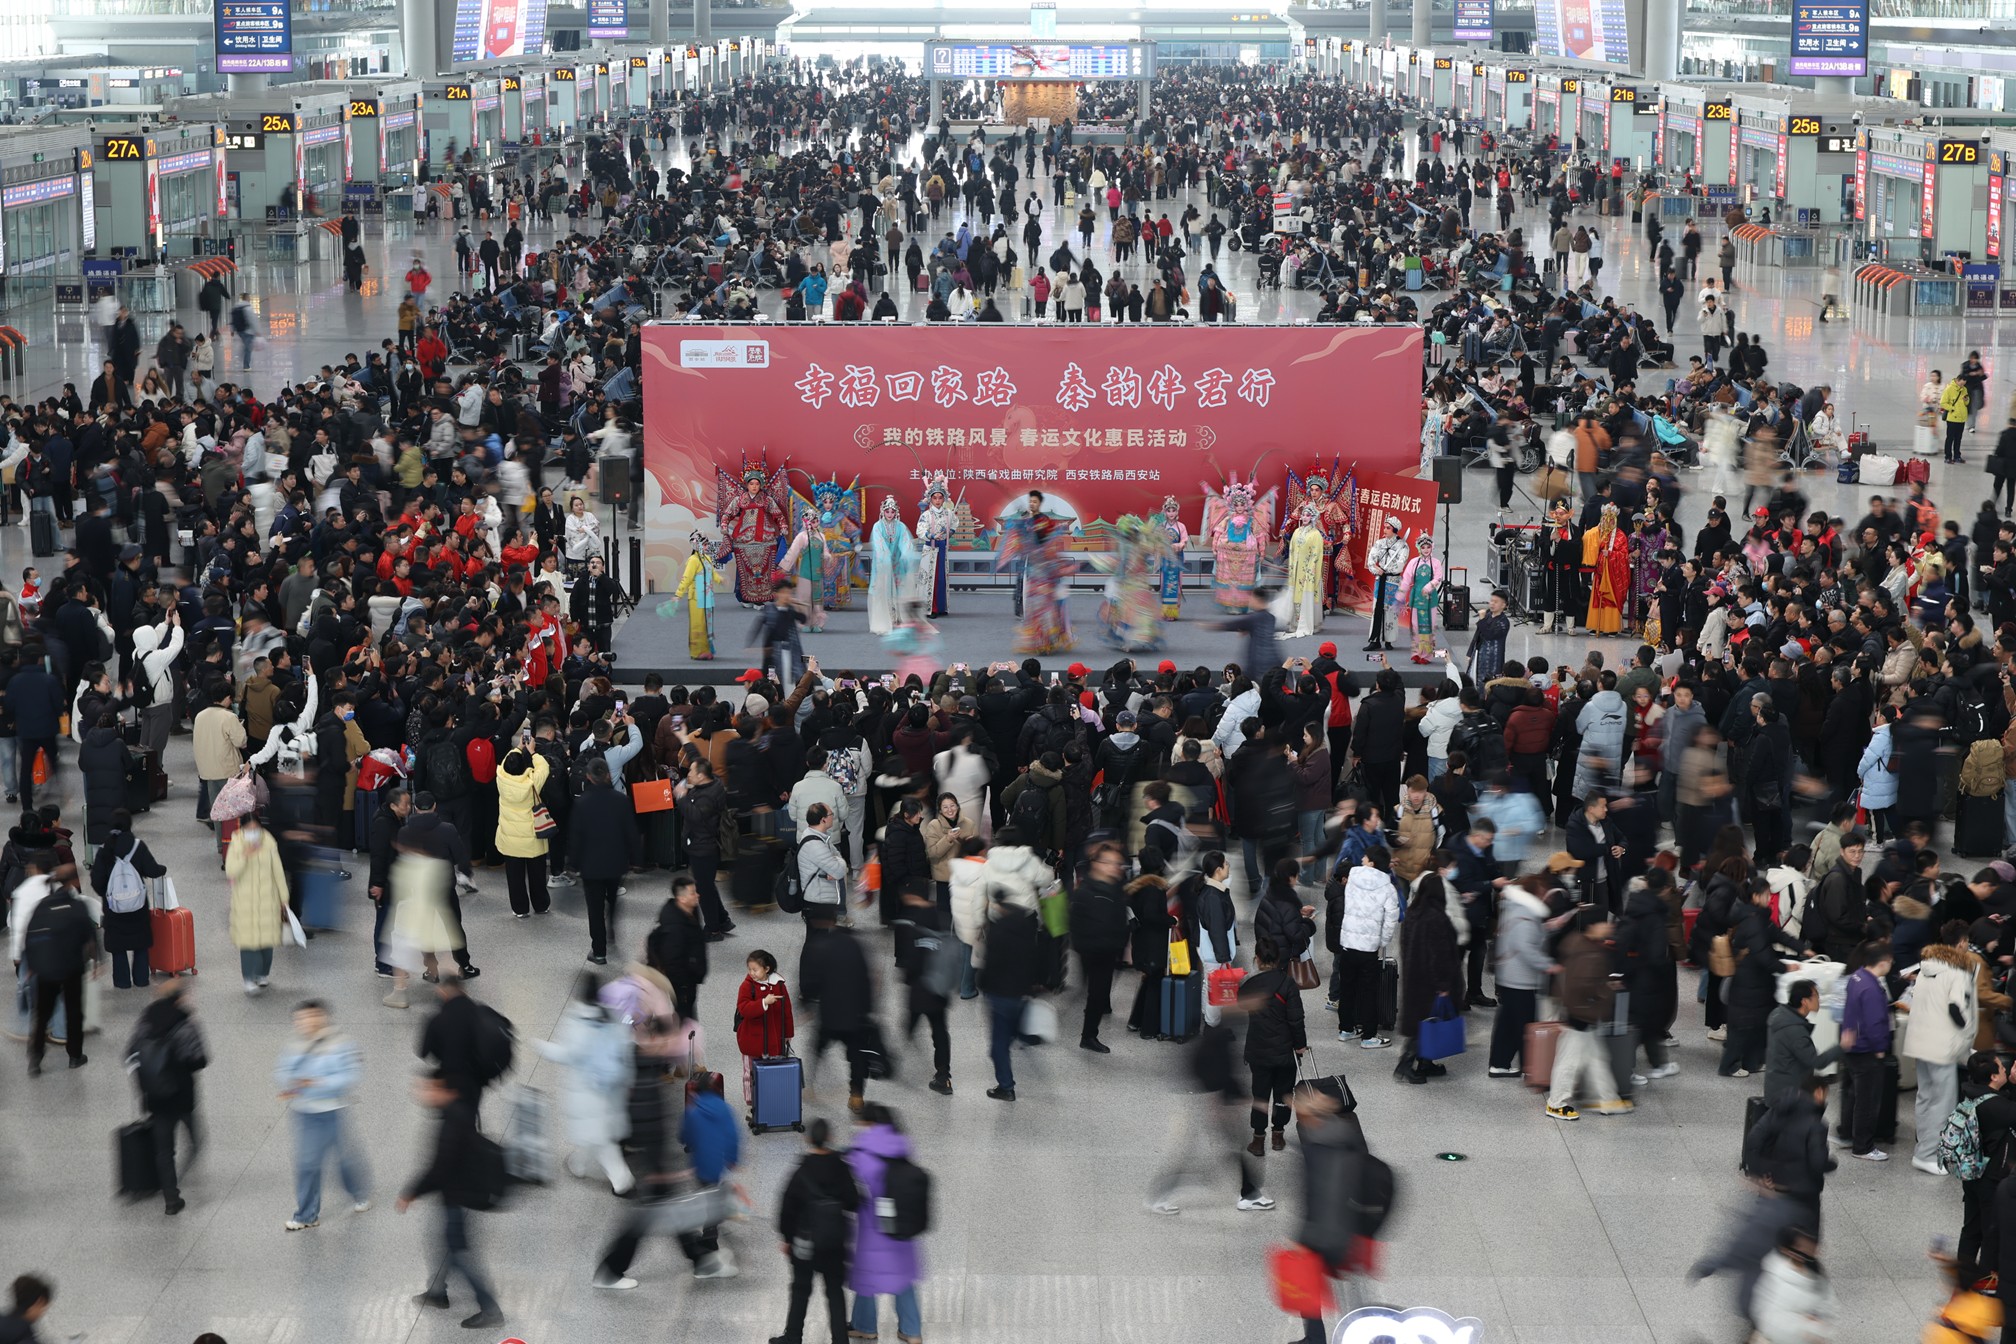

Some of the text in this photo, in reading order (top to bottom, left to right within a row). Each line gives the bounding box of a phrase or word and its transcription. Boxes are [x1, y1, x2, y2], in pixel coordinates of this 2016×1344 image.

[272, 6, 283, 15] 9A
[1849, 9, 1860, 18] 9A
[272, 20, 284, 29] 9B
[1848, 23, 1860, 32] 9B
[234, 36, 282, 44] 饮用水 卫生间
[1825, 39, 1846, 47] 卫生间
[631, 58, 646, 66] 13A
[1435, 60, 1450, 68] 13B
[556, 70, 573, 80] 17A
[1508, 72, 1525, 81] 17B
[447, 87, 468, 98] 21A
[1614, 89, 1634, 101] 21B
[351, 102, 375, 115] 23A
[1707, 105, 1731, 118] 23B
[263, 116, 291, 131] 25A
[1792, 118, 1819, 134] 25B
[108, 139, 156, 158] 27A 27A
[1943, 144, 1976, 162] 27B
[794, 362, 1276, 412] 幸福回家路 秦韵伴君行
[883, 428, 1187, 447] 我的铁路风景 春运文化惠民活动
[1065, 469, 1161, 481] 西安铁路局西安站
